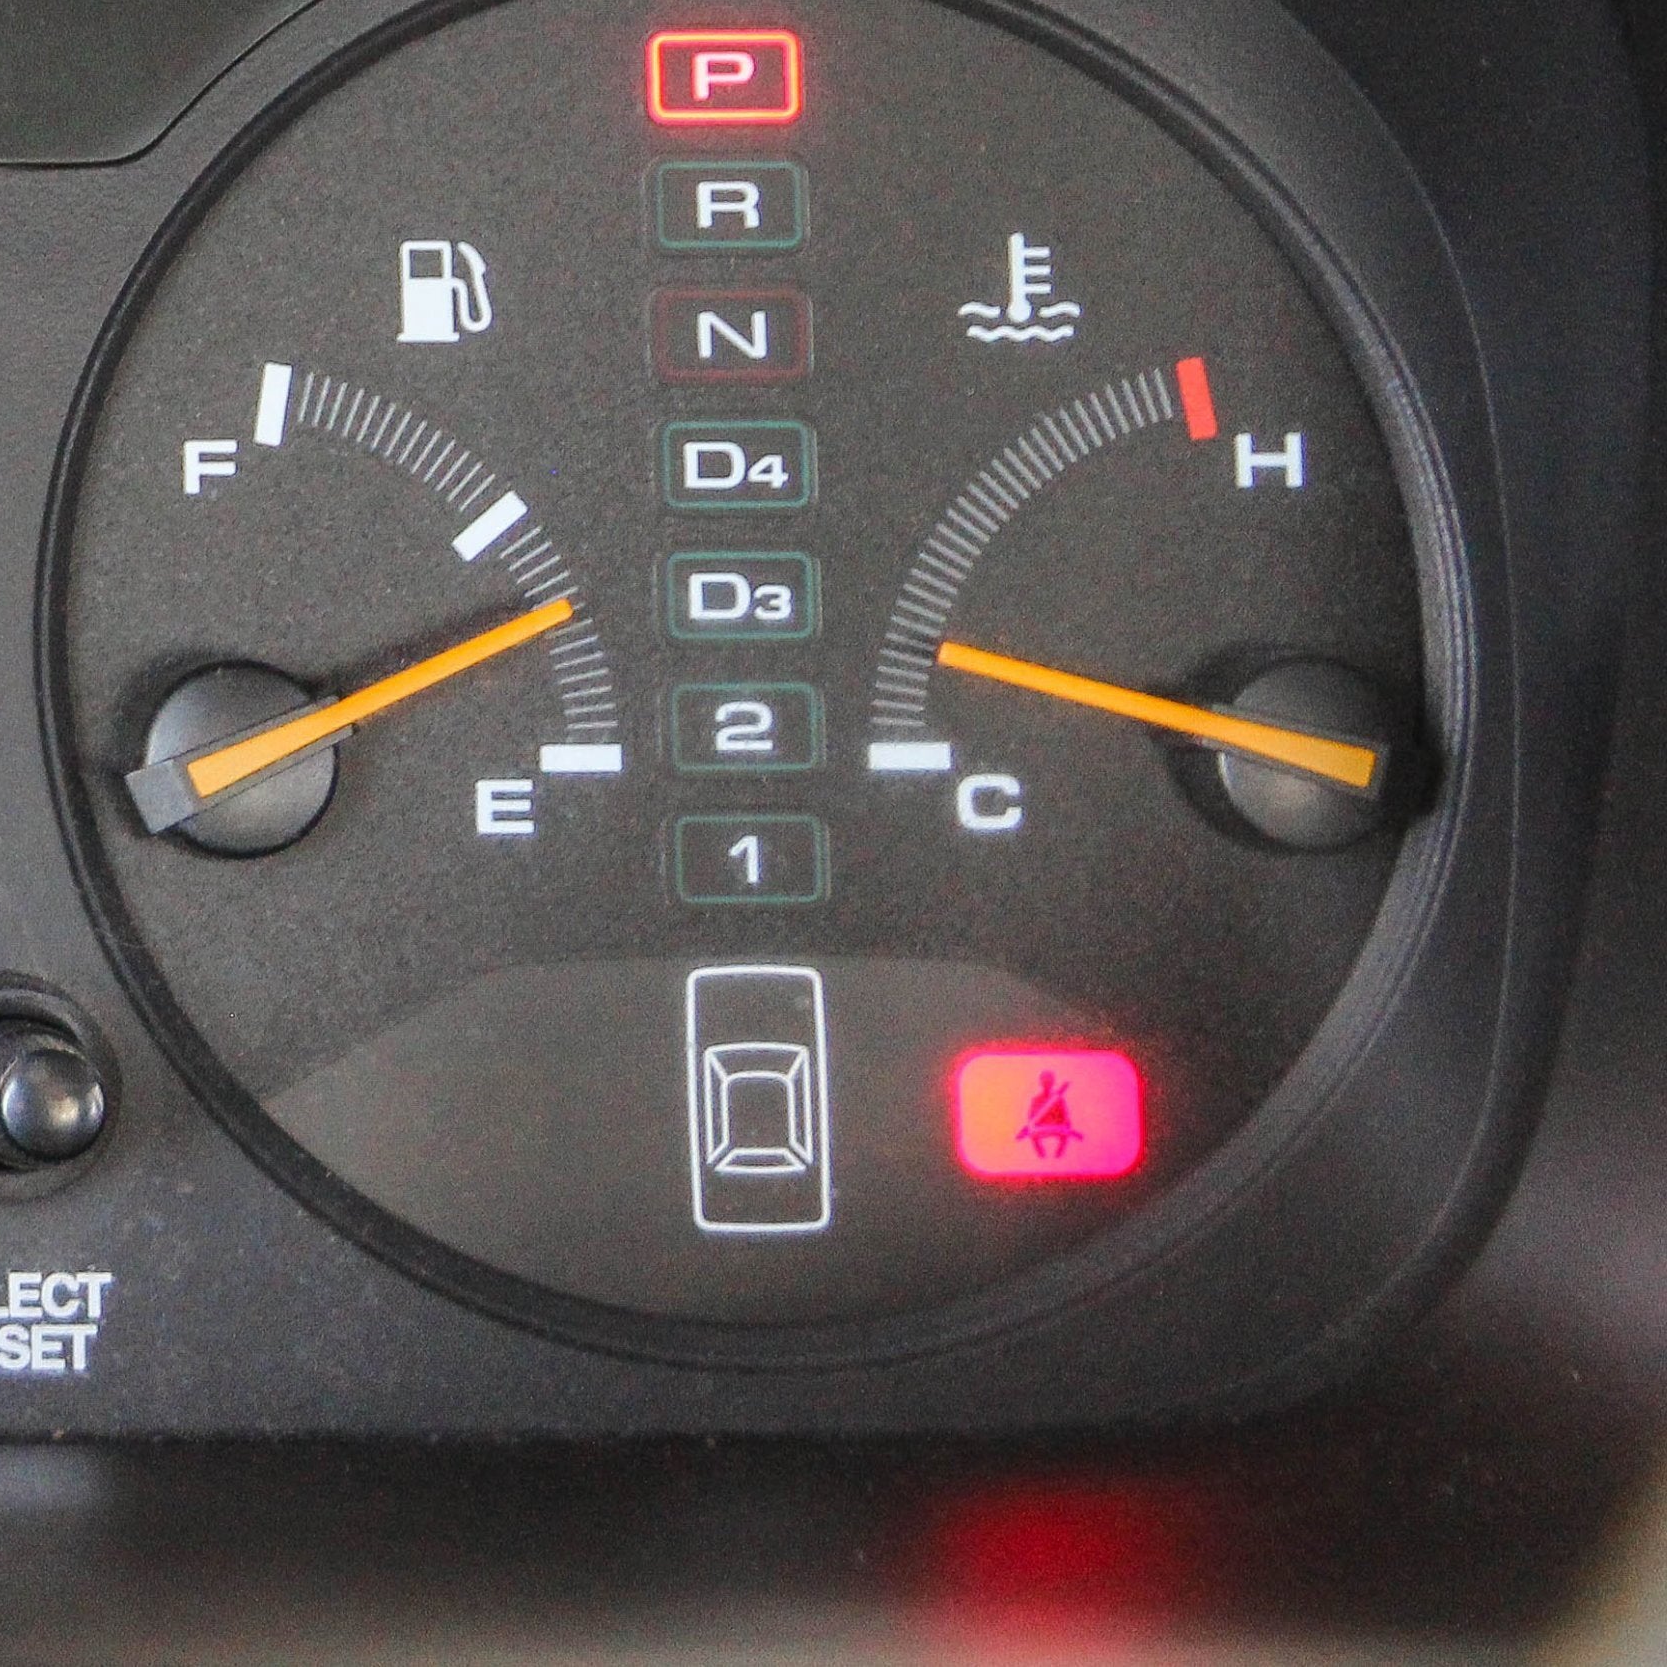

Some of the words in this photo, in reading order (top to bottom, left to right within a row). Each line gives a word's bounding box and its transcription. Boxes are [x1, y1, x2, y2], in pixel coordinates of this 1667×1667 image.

[695, 53, 753, 99] P
[697, 182, 758, 227] R
[698, 312, 766, 358] N
[184, 441, 236, 493] F
[684, 443, 787, 488] D4
[1236, 434, 1302, 487] H
[689, 574, 791, 620] D3
[716, 702, 772, 751] 2
[476, 780, 533, 833] E
[957, 774, 1021, 830] C
[730, 836, 759, 883] 1
